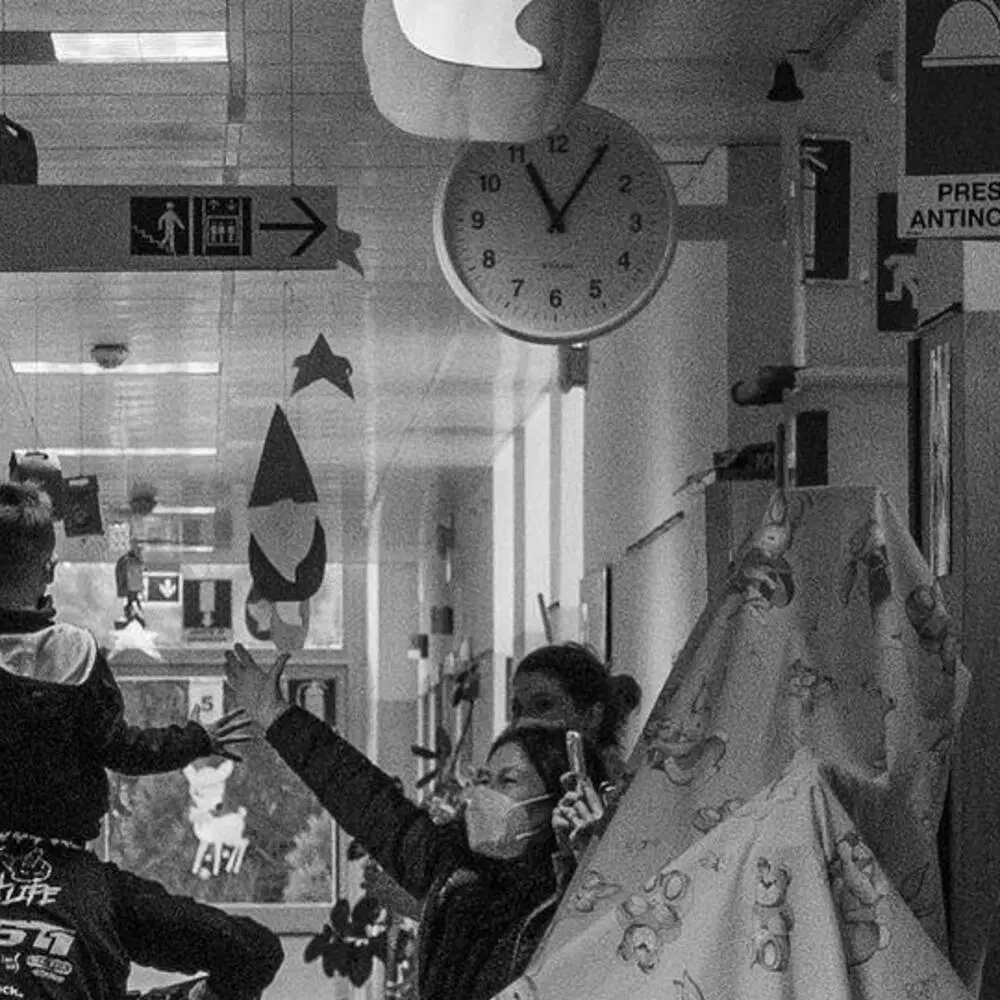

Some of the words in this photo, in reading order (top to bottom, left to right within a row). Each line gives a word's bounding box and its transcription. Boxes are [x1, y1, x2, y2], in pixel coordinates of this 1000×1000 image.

[549, 134, 569, 153] 12
[509, 145, 525, 163] 11
[480, 173, 501, 192] 10
[619, 174, 632, 193] 2
[938, 182, 1000, 202] PRES
[471, 210, 485, 229] 9
[629, 212, 642, 232] 3
[482, 249, 495, 268] 8
[618, 251, 630, 270] 4
[511, 278, 525, 297] 7
[590, 279, 602, 298] 5
[550, 289, 562, 308] 6
[201, 696, 214, 712] 5
[0, 882, 62, 907] LIFE
